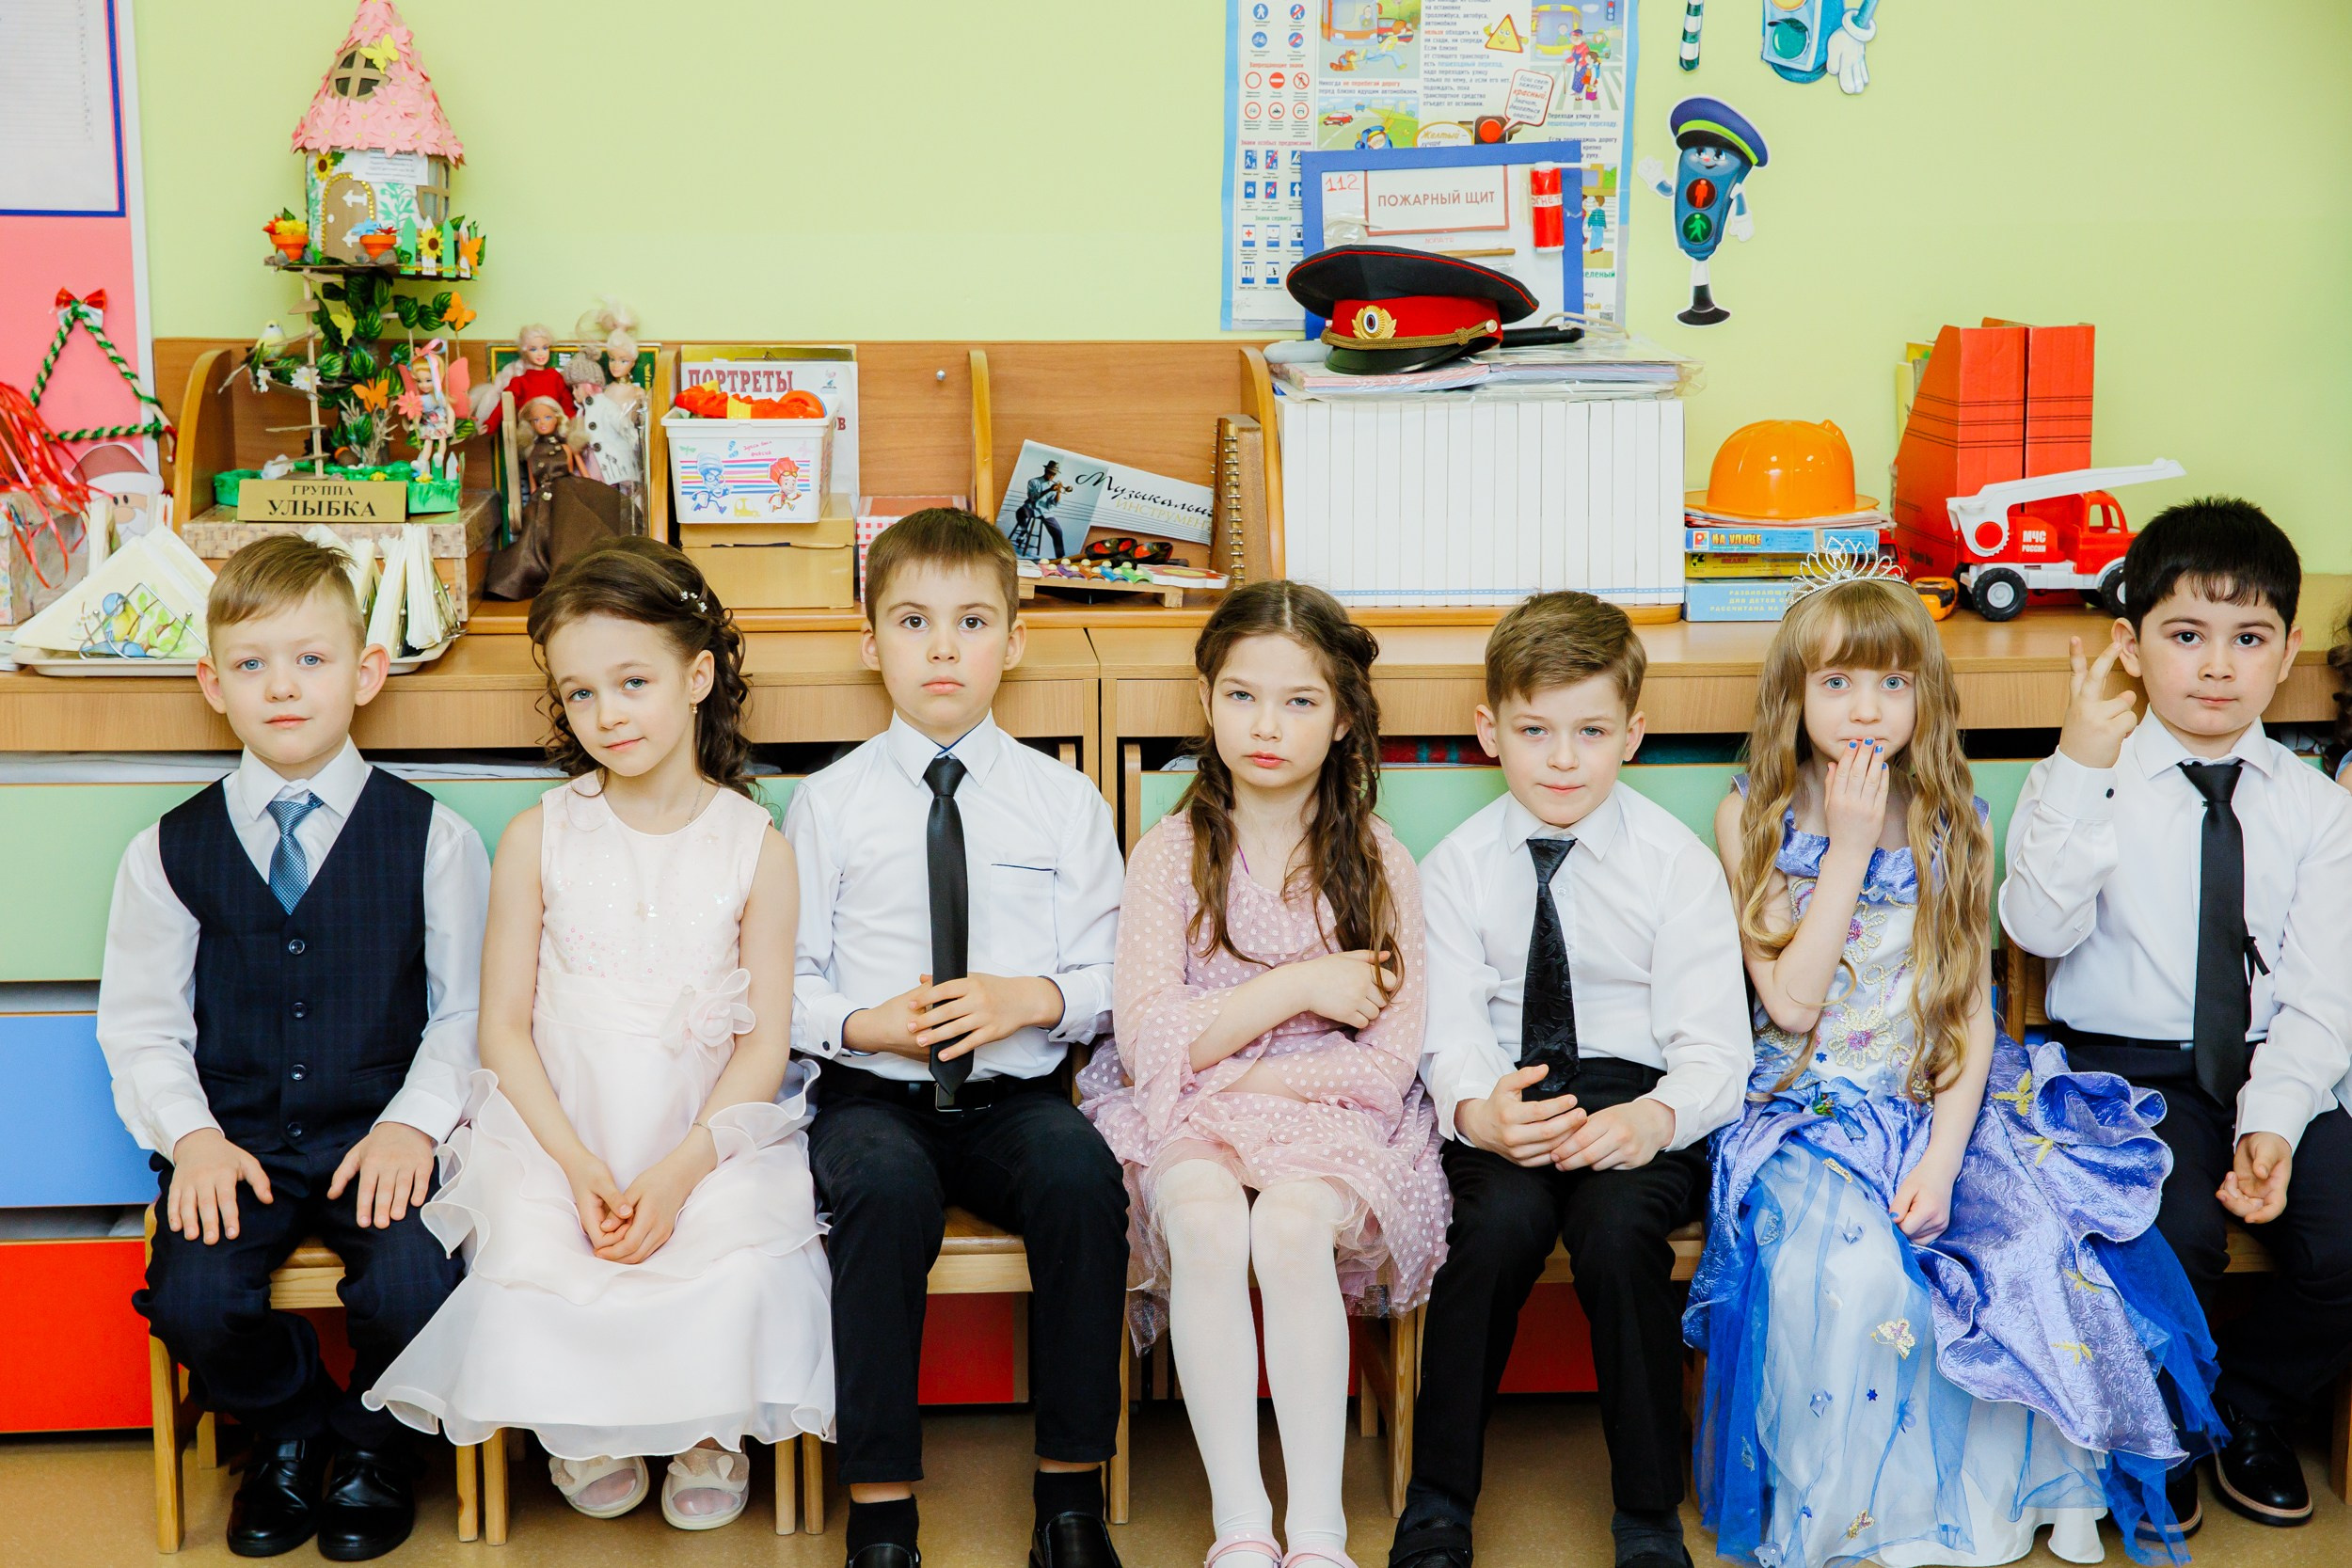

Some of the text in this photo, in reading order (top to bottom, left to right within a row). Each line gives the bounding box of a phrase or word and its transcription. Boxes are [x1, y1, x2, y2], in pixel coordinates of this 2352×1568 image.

[1326, 173, 1359, 192] 112
[1377, 189, 1495, 207] ПОЖАРНЫЙ ЩИТ
[1582, 270, 1616, 278] еленый
[688, 370, 793, 393] ПОРТРЕТЫ
[292, 484, 354, 496] ГРУППА
[268, 499, 376, 517] УЛЫБКА
[1711, 533, 1726, 546] НА
[1728, 533, 1762, 546] УЛИЦЕ
[2023, 530, 2047, 543] МЧС
